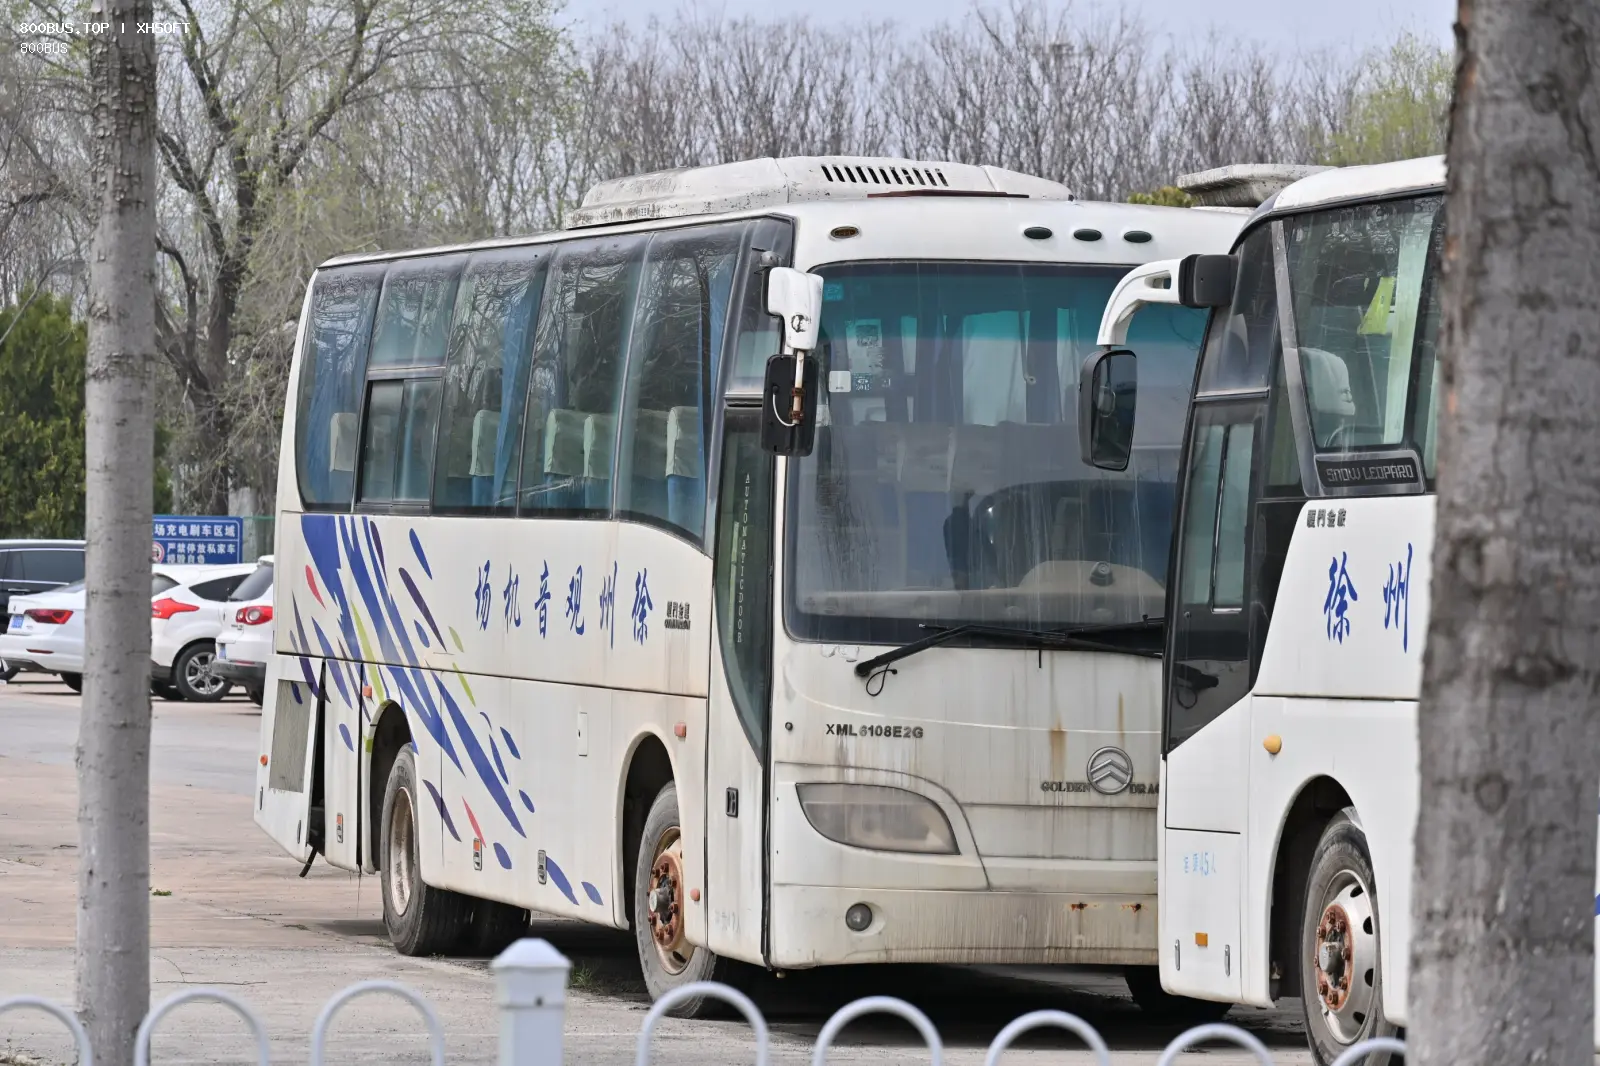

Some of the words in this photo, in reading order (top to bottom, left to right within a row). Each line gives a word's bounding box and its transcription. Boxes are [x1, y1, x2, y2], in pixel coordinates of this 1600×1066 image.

[1326, 466, 1361, 482] SNOW
[1362, 464, 1414, 480] LEOPARD
[152, 524, 236, 537] 场充电刷车区域
[1040, 781, 1091, 793] GOLDEN
